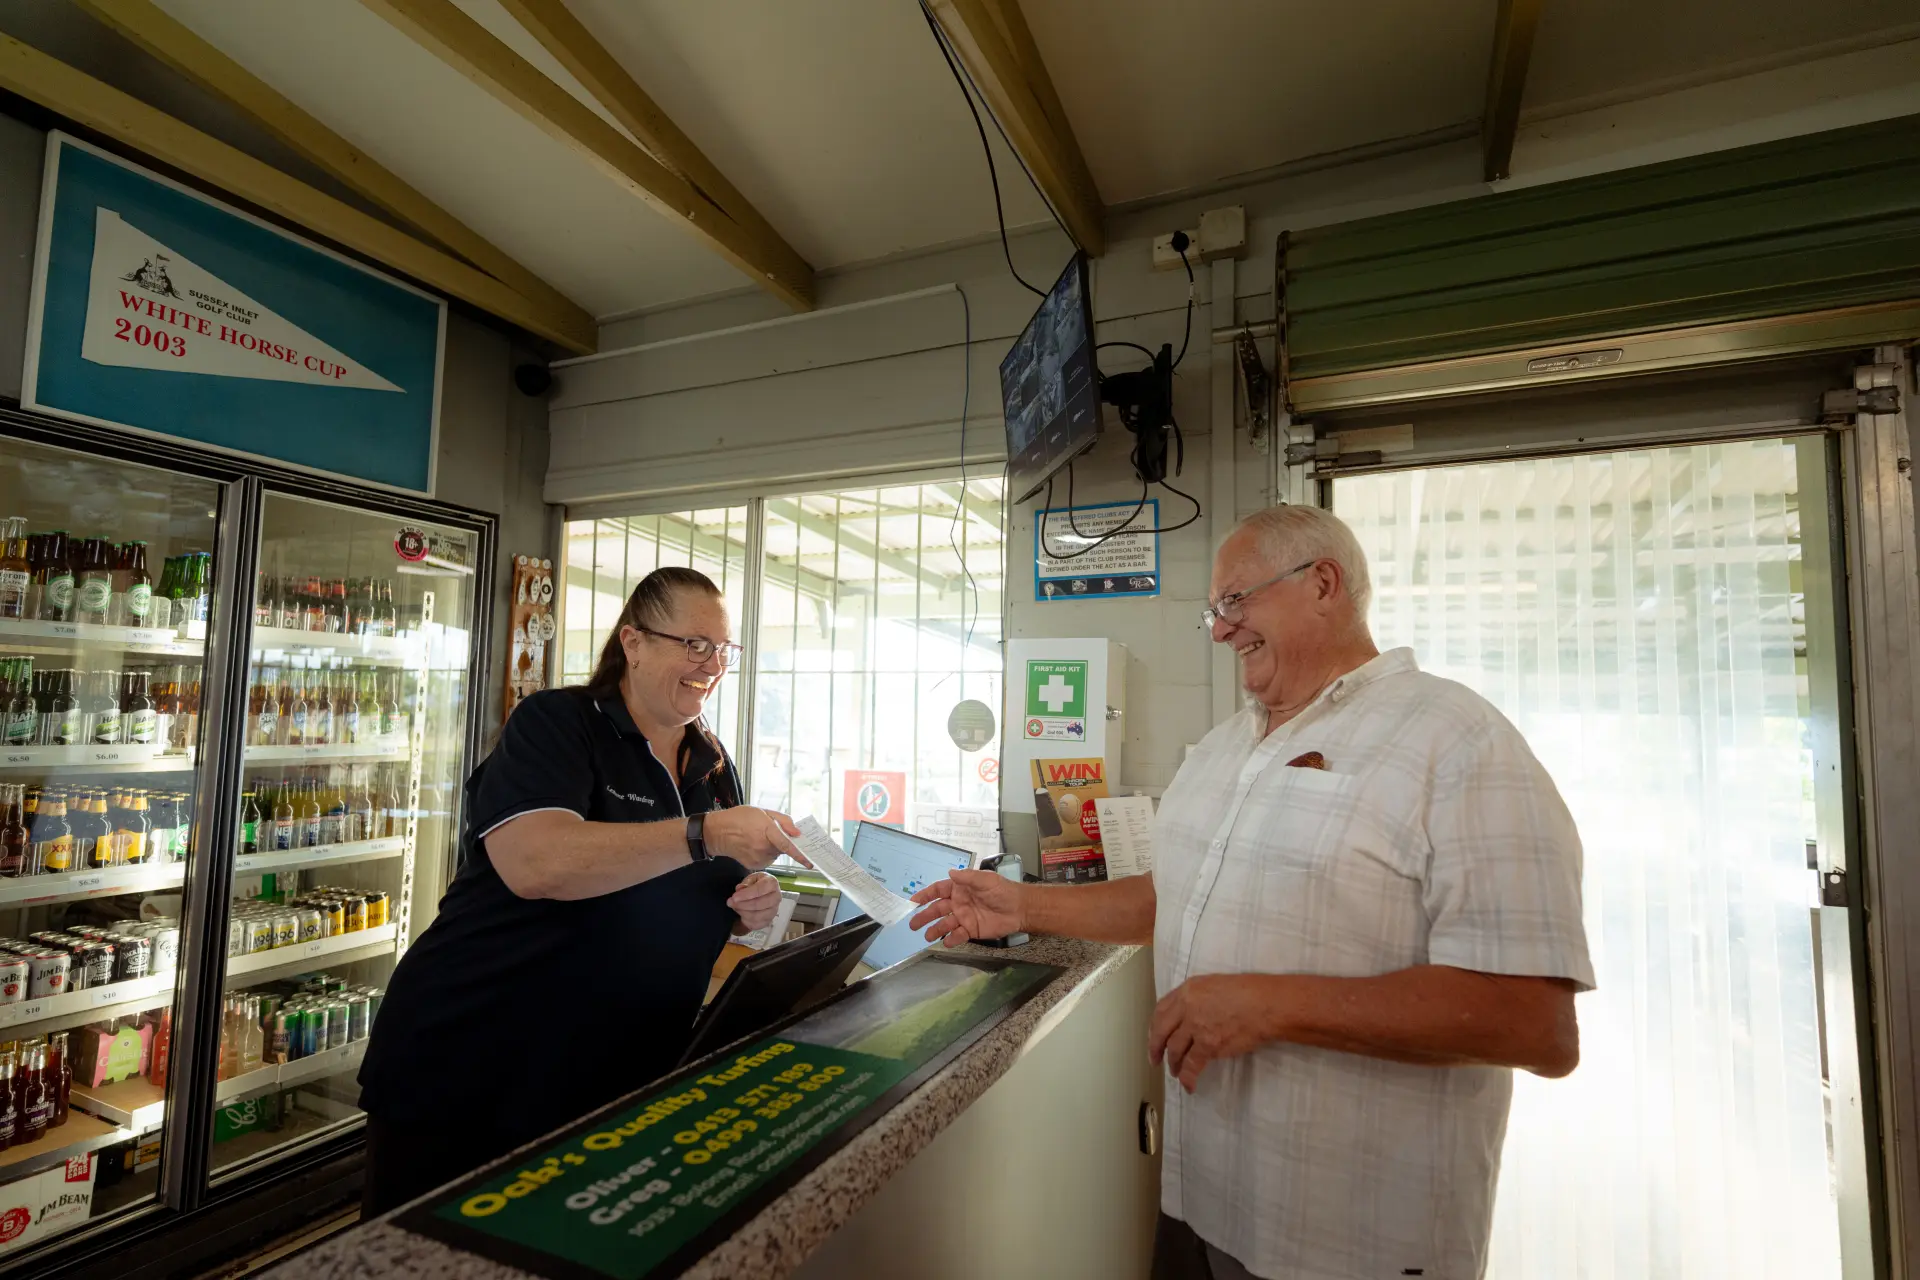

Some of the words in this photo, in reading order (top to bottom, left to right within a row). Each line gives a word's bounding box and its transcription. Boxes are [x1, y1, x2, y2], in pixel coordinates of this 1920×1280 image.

[189, 289, 229, 309] SUSSEX
[231, 304, 260, 320] INLET
[196, 301, 225, 315] GOLF
[226, 311, 251, 325] CLUB
[114, 317, 187, 357] 2003
[118, 289, 213, 337] WHITE
[218, 324, 299, 366] HORSE
[303, 355, 347, 380] CUP
[7, 755, 30, 763] $6.50
[95, 753, 119, 761] $6.00
[1048, 763, 1101, 782] WIN
[78, 878, 100, 887] $6.50
[37, 967, 55, 981] JIM
[102, 991, 117, 1000] $10
[25, 1006, 41, 1015] $10
[460, 1153, 587, 1217] Oak's
[583, 1087, 708, 1150] Quality
[696, 1041, 796, 1087] Turfing
[564, 1156, 657, 1210] Oliver
[673, 1107, 741, 1144] 0413
[734, 1083, 780, 1107] 571
[772, 1063, 814, 1083] 189
[588, 1178, 672, 1225] Greg
[683, 1119, 758, 1165] 0499
[754, 1091, 804, 1119] 385
[796, 1065, 846, 1091] 800
[68, 1151, 89, 1168] 24
[34, 1200, 57, 1226] JIM
[58, 1193, 90, 1208] BEAM
[3, 1219, 14, 1232] B
